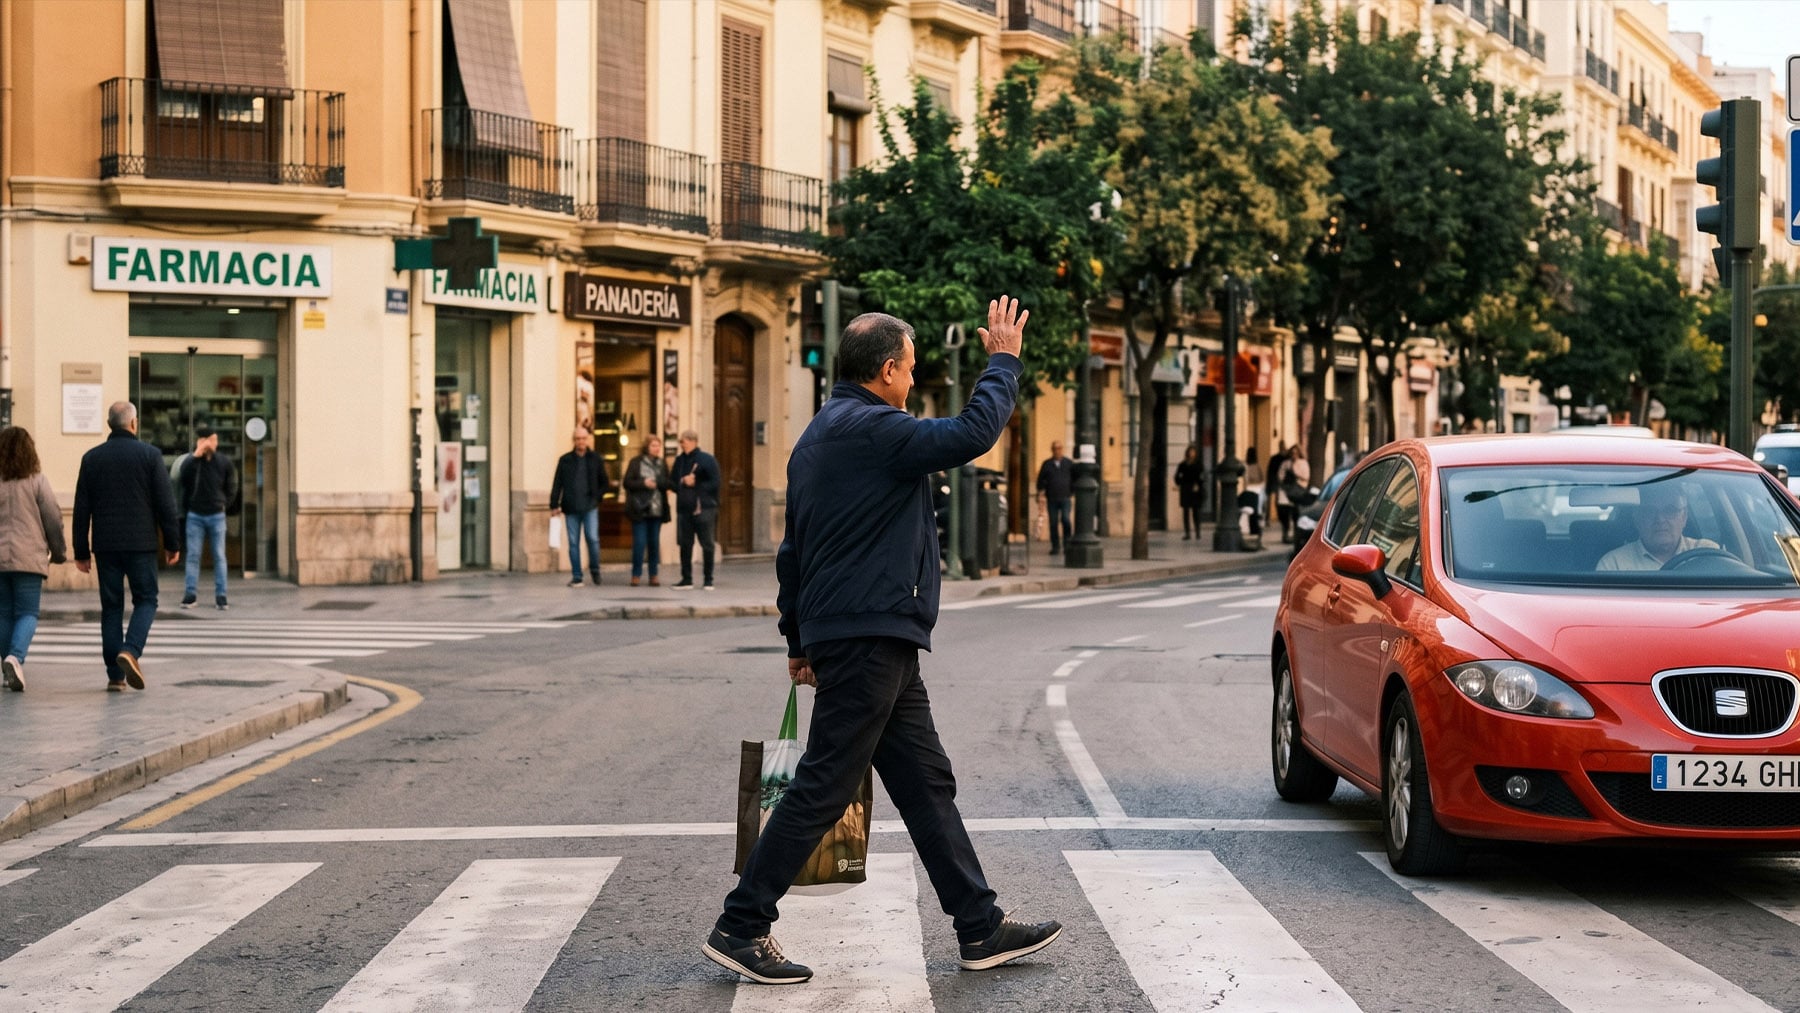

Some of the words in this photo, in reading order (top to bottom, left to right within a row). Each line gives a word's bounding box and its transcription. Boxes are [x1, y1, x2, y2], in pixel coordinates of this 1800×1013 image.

[108, 247, 320, 287] FARMACIA
[432, 268, 537, 304] FMACIA
[585, 283, 680, 319] PANADERÍA
[1656, 775, 1663, 783] E
[1678, 760, 1747, 787] 1234
[1759, 760, 1800, 787] GH
